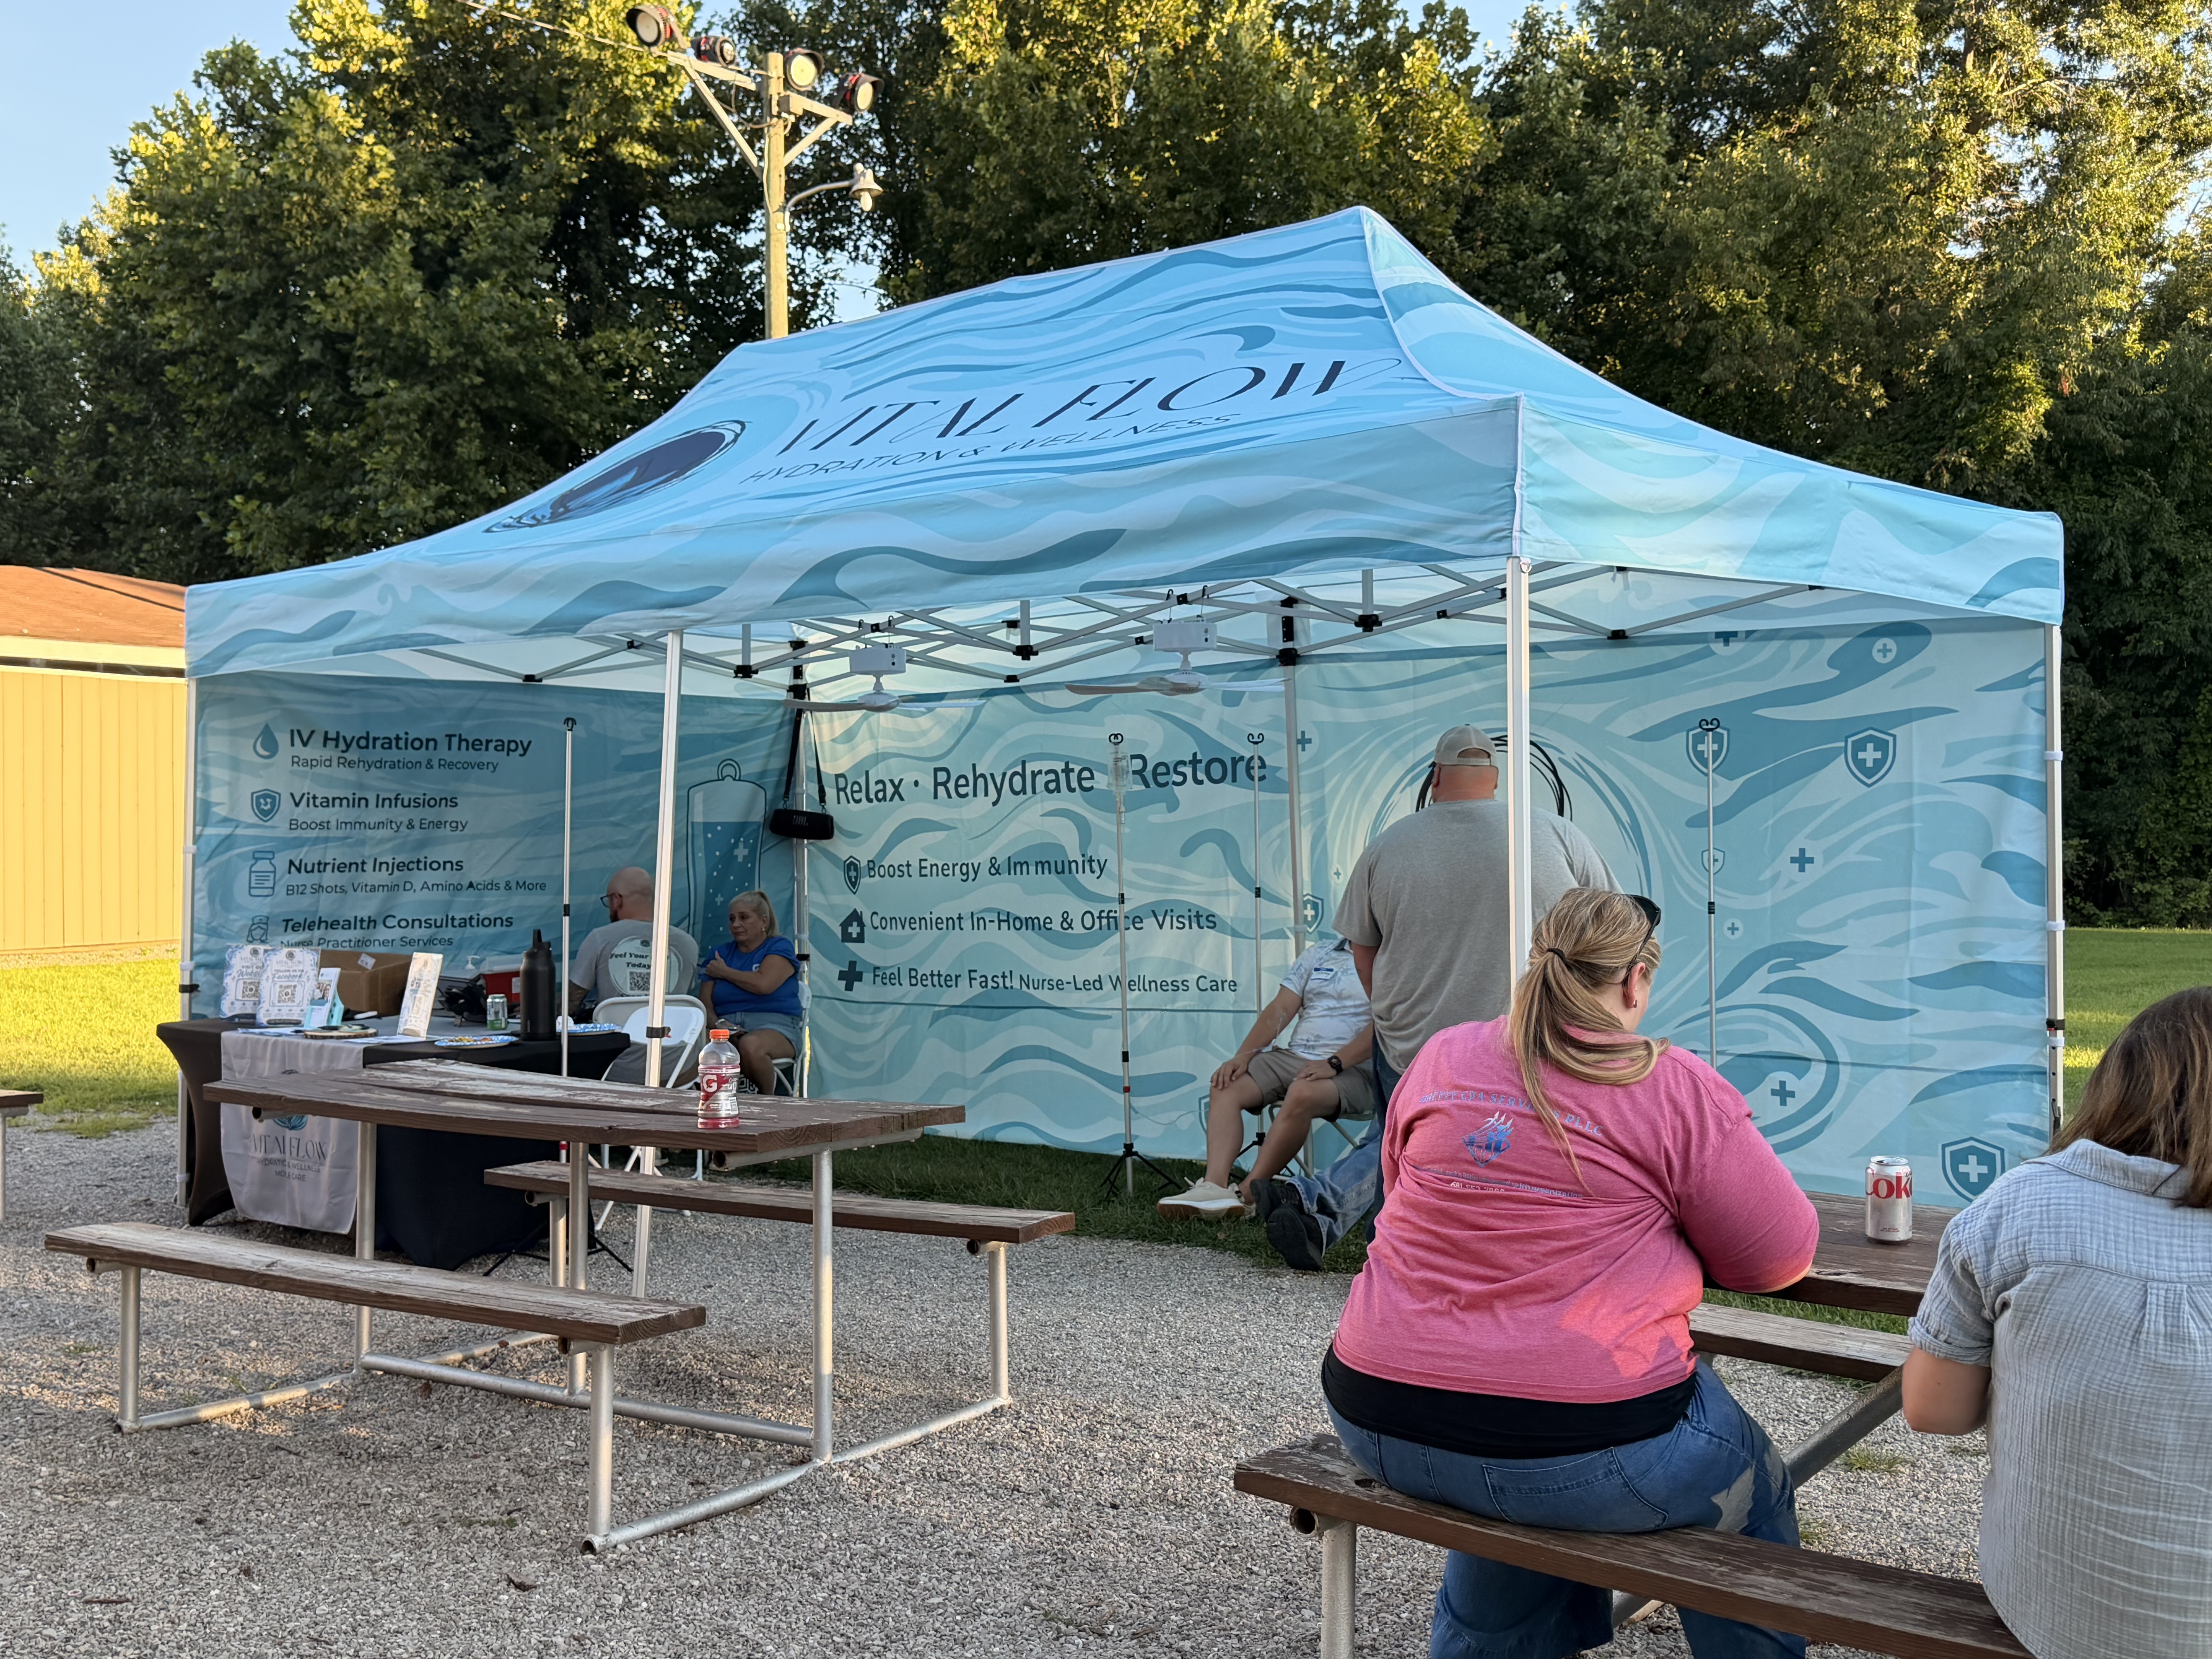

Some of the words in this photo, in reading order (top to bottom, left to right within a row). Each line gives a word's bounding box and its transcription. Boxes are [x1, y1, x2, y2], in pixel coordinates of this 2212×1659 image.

[776, 393, 1025, 457] VITAL
[1031, 359, 1402, 429] FLOW
[738, 448, 960, 484] HYDRATION
[958, 445, 991, 459] &
[1001, 414, 1241, 453] WELLNESS
[289, 729, 315, 748] IV
[323, 730, 438, 754] Hydration
[445, 733, 532, 757] Therapy
[291, 755, 333, 771] Rapid
[337, 756, 422, 771] Rehydration
[425, 758, 434, 770] &
[438, 758, 499, 773] Recovery
[835, 770, 905, 805] Relax
[933, 760, 1096, 806] Rehydrate
[1130, 751, 1267, 788] Restore
[289, 792, 369, 809] Vitamin
[375, 793, 459, 809] Infusions
[289, 818, 331, 831] Boost
[335, 817, 404, 832] Immunity
[406, 818, 415, 830] &
[419, 818, 468, 833] Energy
[793, 815, 808, 826] JBL
[288, 857, 367, 875] Nutrient
[372, 857, 464, 876] Injections
[867, 859, 913, 879] Boost
[919, 858, 981, 882] Energy
[988, 858, 1001, 876] &
[1007, 854, 1108, 879] Immunity
[286, 883, 307, 896] B12
[309, 883, 349, 896] Shots,
[351, 881, 400, 893] Vitamin
[403, 880, 417, 893] D,
[420, 879, 463, 892] Amino
[466, 879, 501, 891] Acids
[503, 880, 513, 891] &
[515, 879, 547, 891] More
[282, 915, 377, 933] Telehealth
[382, 914, 514, 929] Consultations
[870, 911, 962, 932] Convenient
[970, 910, 1053, 931] In-Home
[1060, 910, 1074, 931] &
[1081, 909, 1144, 931] Office
[1151, 908, 1218, 931] Visits
[317, 937, 396, 948] Practitioner
[400, 936, 453, 947] Services
[872, 966, 903, 987] Feel
[908, 967, 960, 989] Better
[969, 969, 1015, 990] Fast!
[1019, 974, 1104, 992] Nurse-Led
[1108, 974, 1190, 993] Wellness
[1195, 975, 1238, 993] Care
[703, 1074, 718, 1092] G
[1564, 1113, 1604, 1136] PLLC
